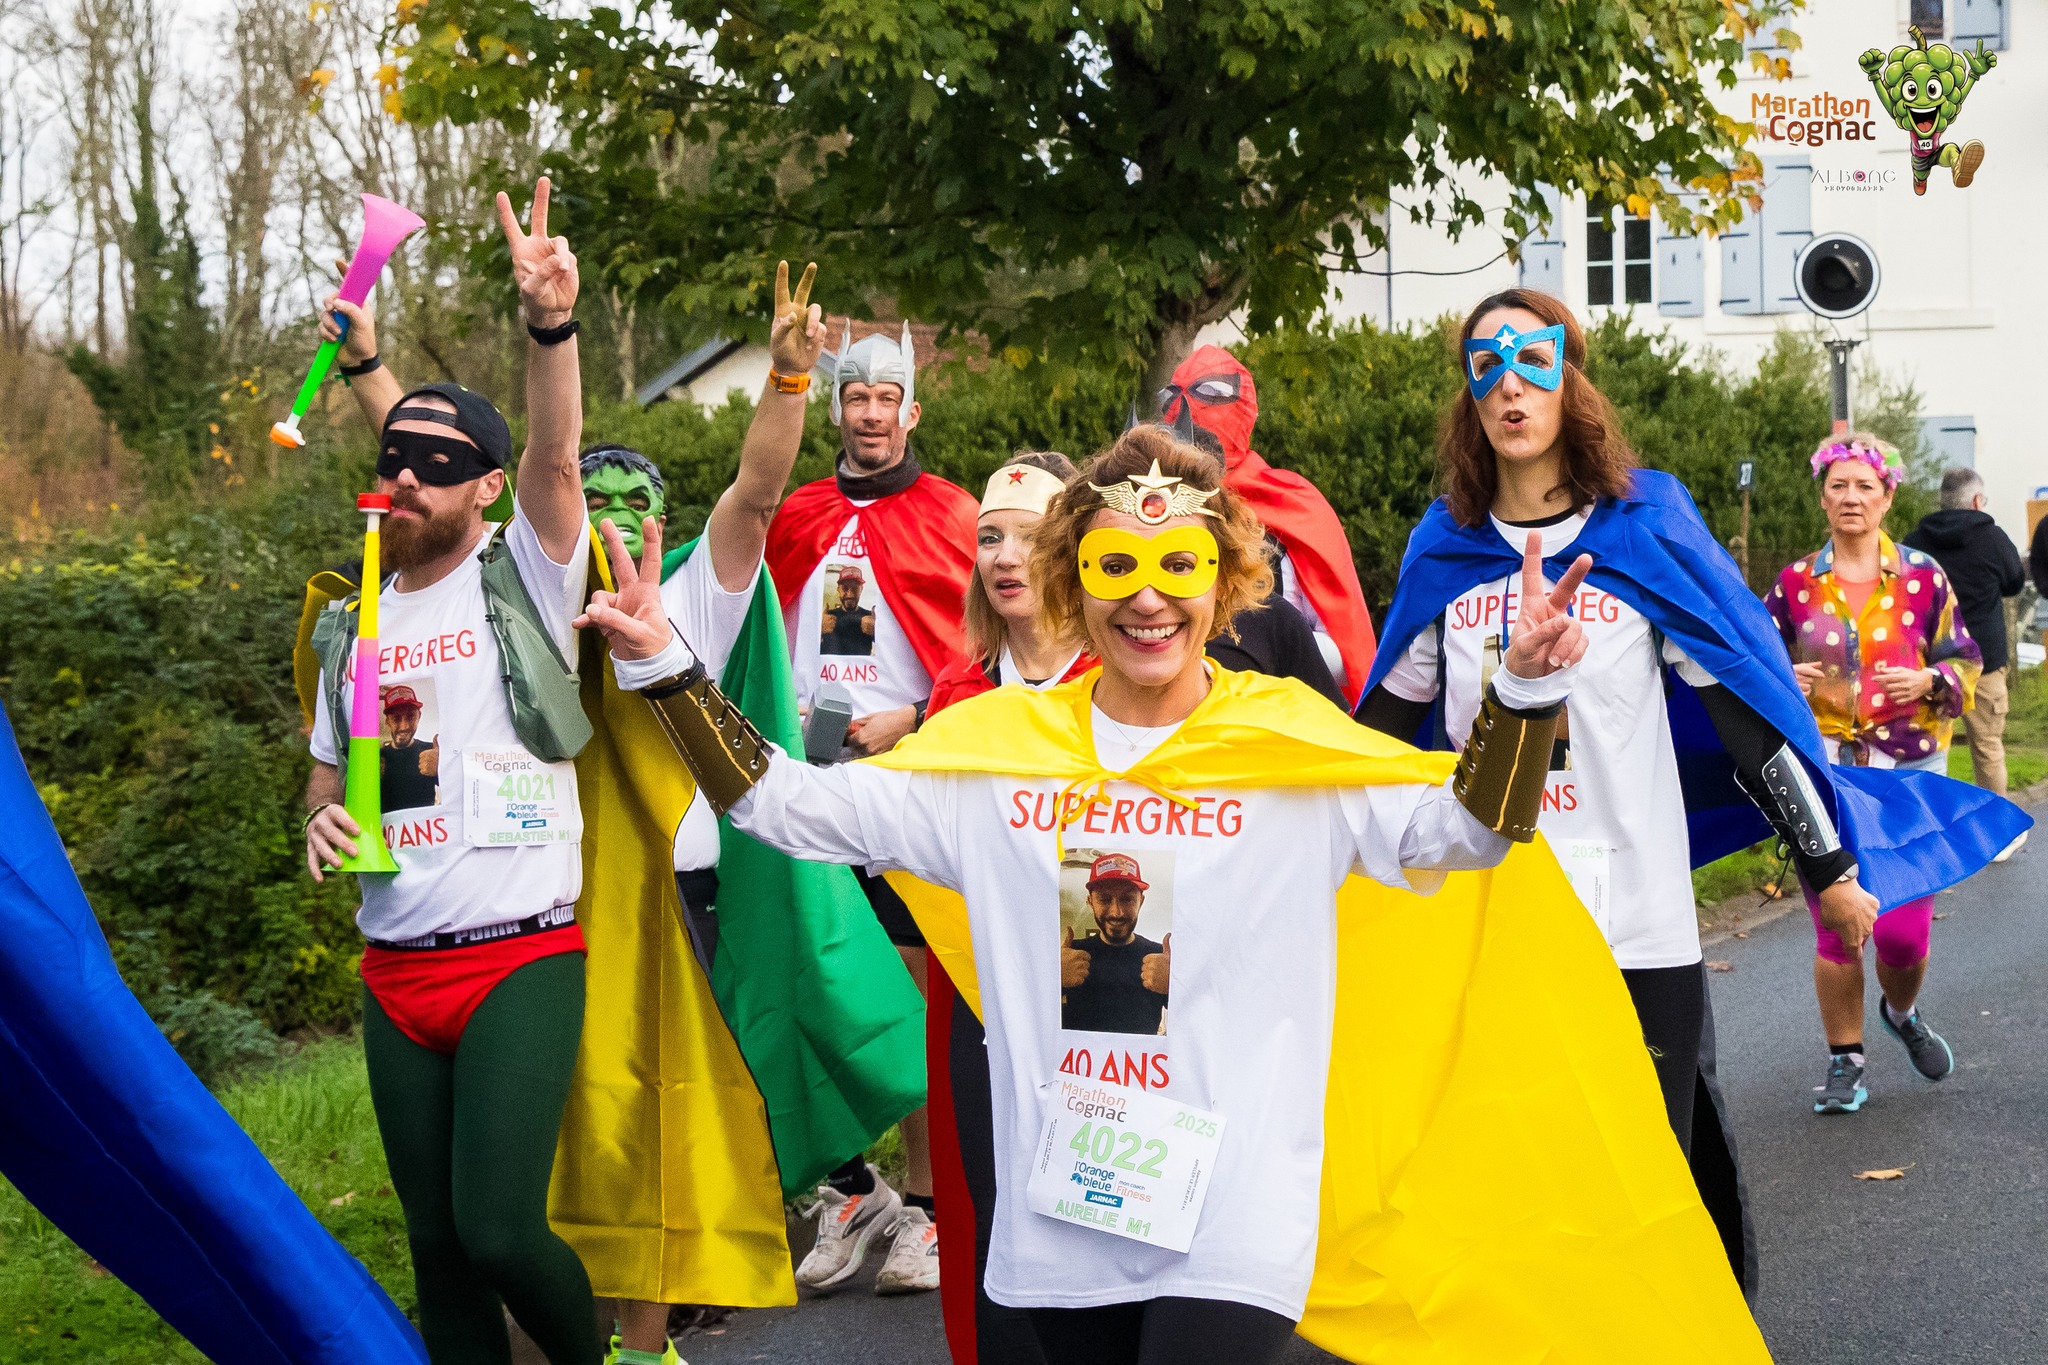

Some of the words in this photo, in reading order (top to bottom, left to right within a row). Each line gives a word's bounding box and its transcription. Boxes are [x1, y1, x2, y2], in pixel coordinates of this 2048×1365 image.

[820, 664, 837, 681] 40
[842, 665, 878, 682] ANS
[475, 750, 530, 762] Marathon
[485, 761, 532, 773] Cognac
[497, 773, 555, 801] 4021
[1541, 784, 1577, 814] NS
[517, 811, 538, 819] bleue
[1010, 790, 1242, 838] SUPERGREG
[399, 818, 448, 848] ANS
[488, 831, 554, 843] SEBASTIEN
[1571, 844, 1604, 858] 2025
[1059, 1048, 1092, 1078] 40
[1099, 1049, 1170, 1091] ANS
[1061, 1080, 1127, 1110] Marathon
[1067, 1096, 1127, 1122] Cognac
[1173, 1111, 1218, 1138] 2025
[1069, 1121, 1169, 1178] 4022
[1074, 1161, 1115, 1181] l'Orange
[1083, 1176, 1112, 1192] bleue
[1116, 1185, 1152, 1202] Fitness
[1089, 1194, 1118, 1206] JARNAC
[1055, 1199, 1119, 1229] AURELIE
[1126, 1217, 1152, 1237] M1
